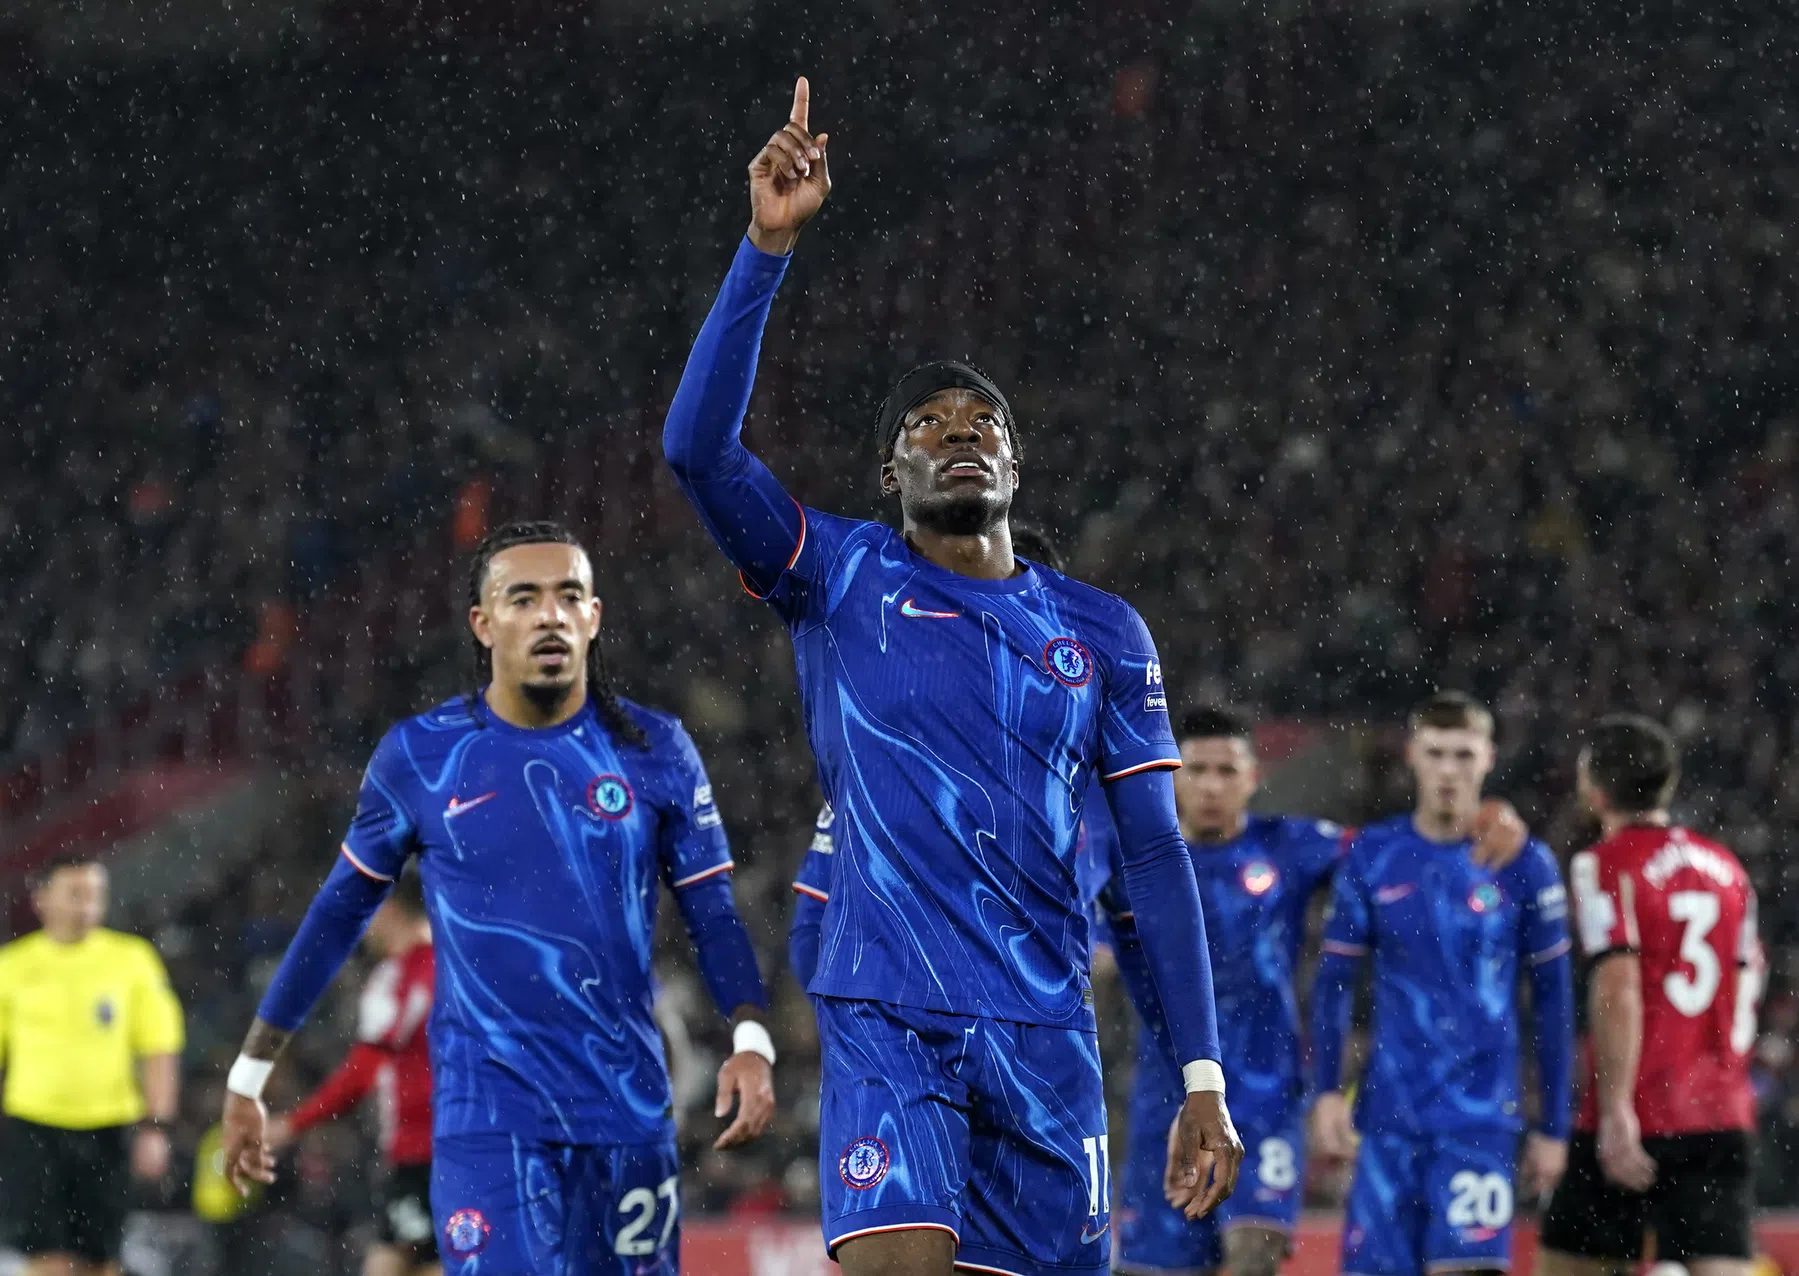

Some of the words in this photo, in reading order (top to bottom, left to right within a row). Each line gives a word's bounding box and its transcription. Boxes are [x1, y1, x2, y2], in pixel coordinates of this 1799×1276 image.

[1052, 640, 1083, 653] CHELSEA
[1146, 659, 1161, 685] fe
[1663, 890, 1721, 1017] 3
[1083, 1134, 1109, 1216] 11
[1257, 1136, 1297, 1190] 8
[1446, 1170, 1513, 1229] 20
